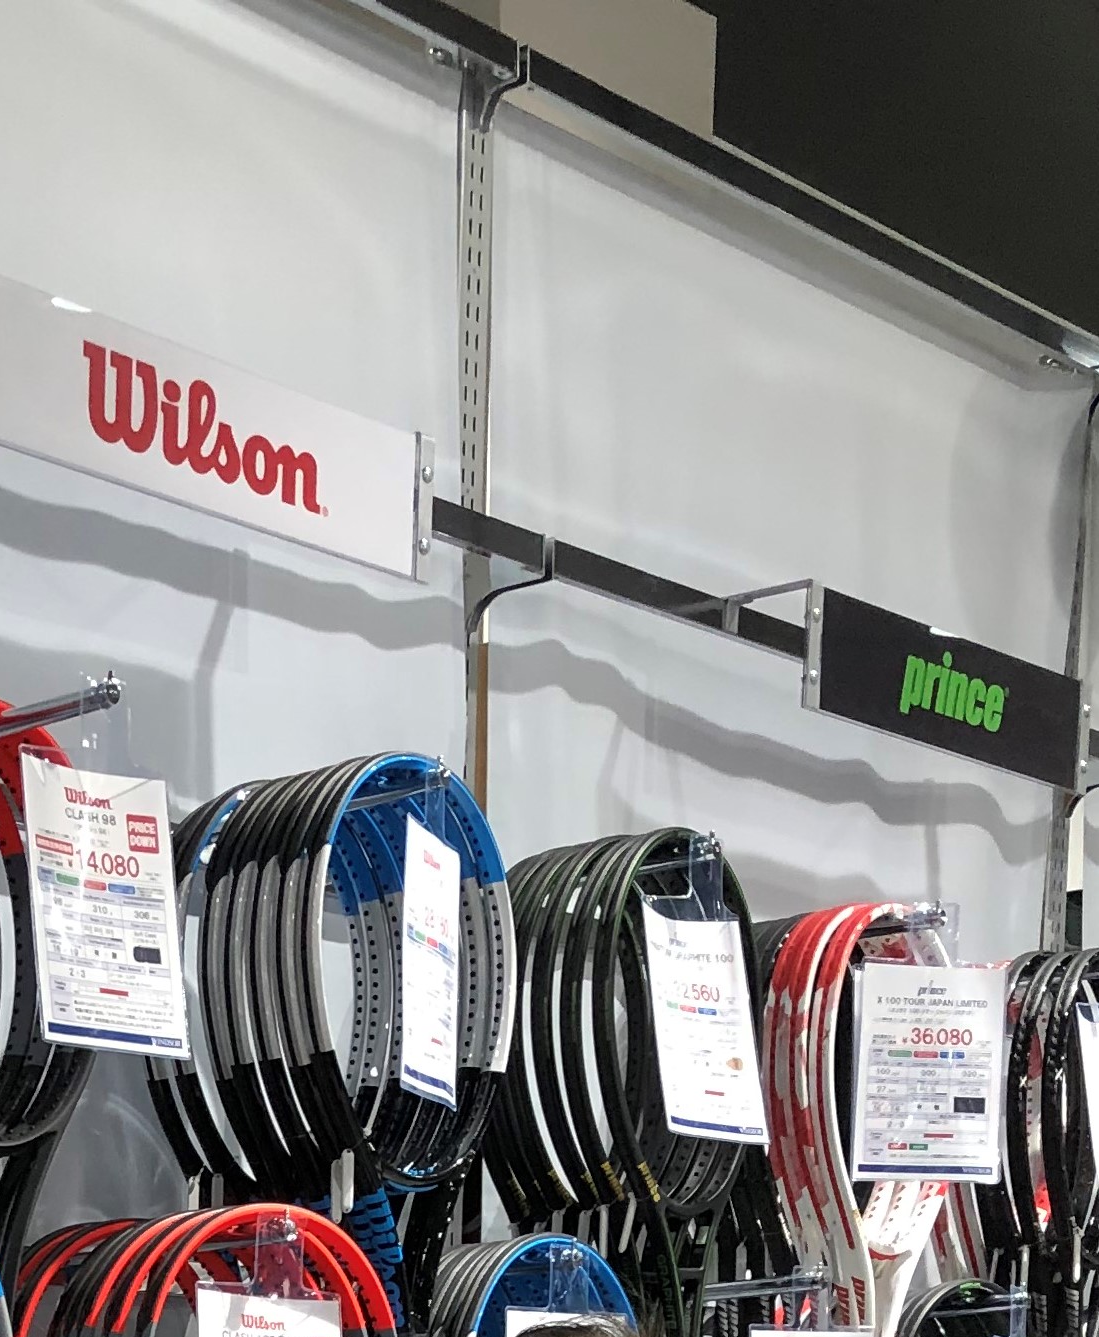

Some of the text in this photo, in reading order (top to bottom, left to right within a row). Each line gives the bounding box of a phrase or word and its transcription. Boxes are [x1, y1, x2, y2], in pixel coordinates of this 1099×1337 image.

[83, 339, 323, 517] Wilson
[900, 651, 1006, 733] prince
[64, 786, 113, 810] Wilson
[65, 807, 117, 826] CLAH 98
[128, 821, 156, 835] PRICE
[903, 997, 926, 1006] TOUR
[927, 998, 953, 1007] JAPAN
[956, 1000, 989, 1009] LIMITED
[240, 1313, 286, 1332] Wilson
